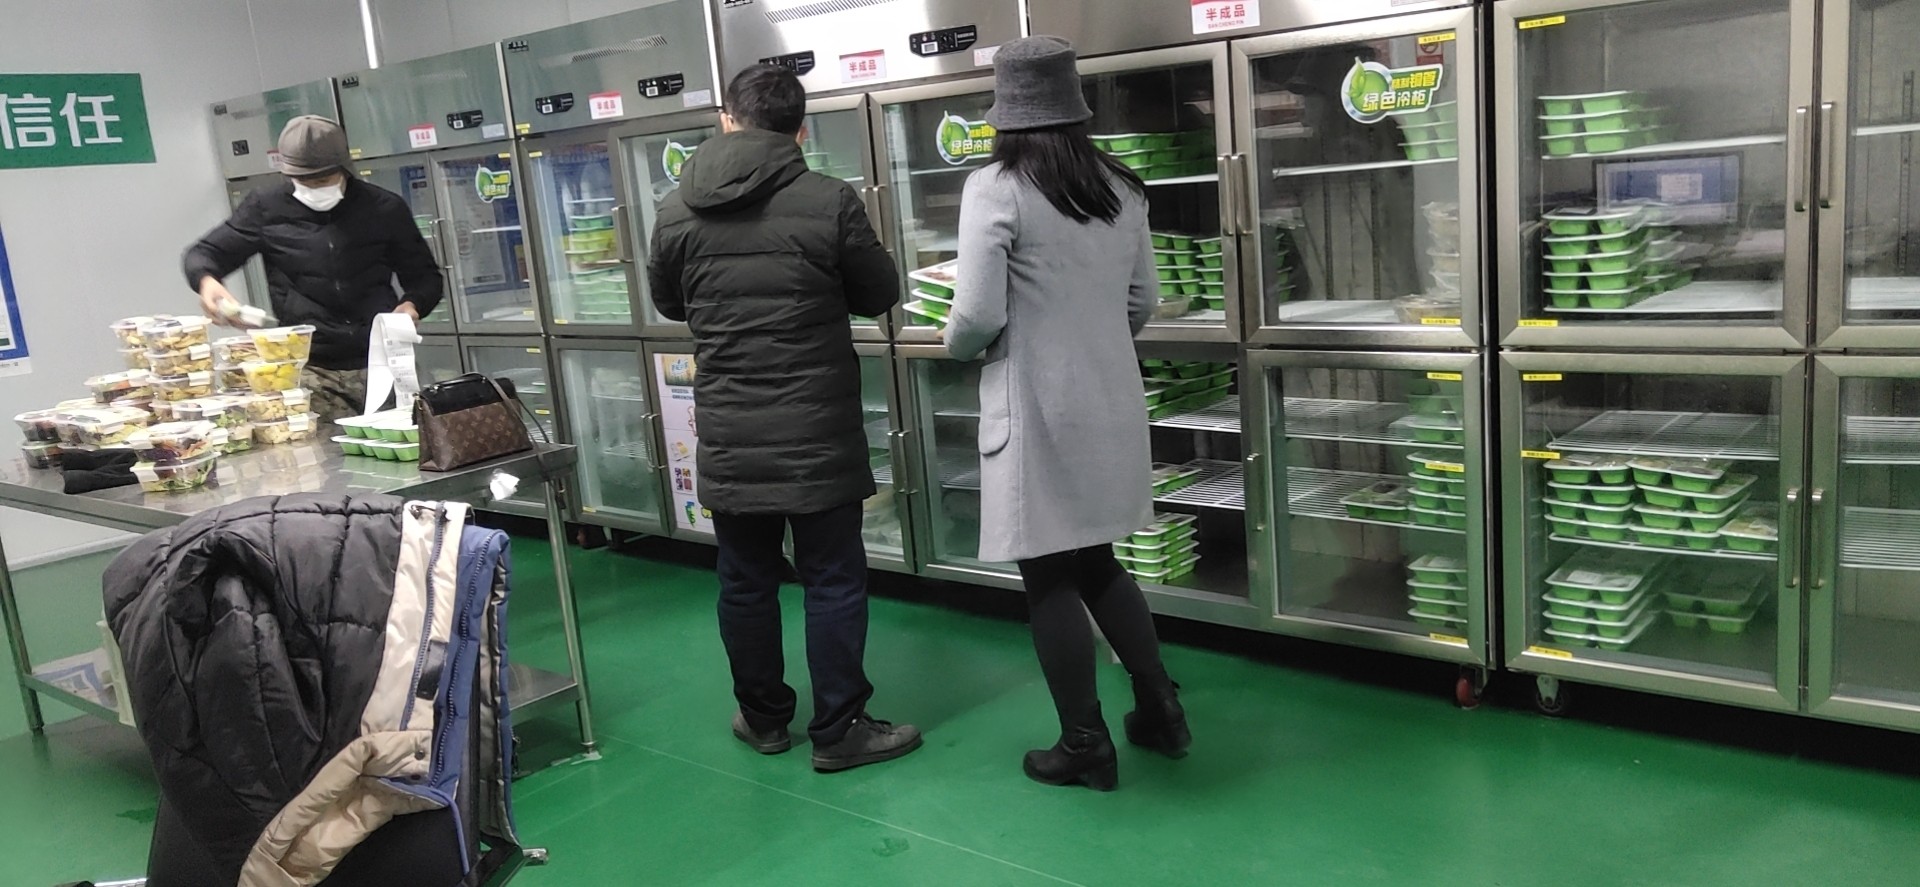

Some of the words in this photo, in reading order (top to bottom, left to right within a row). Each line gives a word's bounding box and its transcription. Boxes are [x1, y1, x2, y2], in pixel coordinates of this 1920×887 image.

[1206, 4, 1245, 21] 半成品
[849, 59, 877, 73] 半成品
[1362, 90, 1427, 112] 绿色冷柜
[0, 92, 123, 150] 信任
